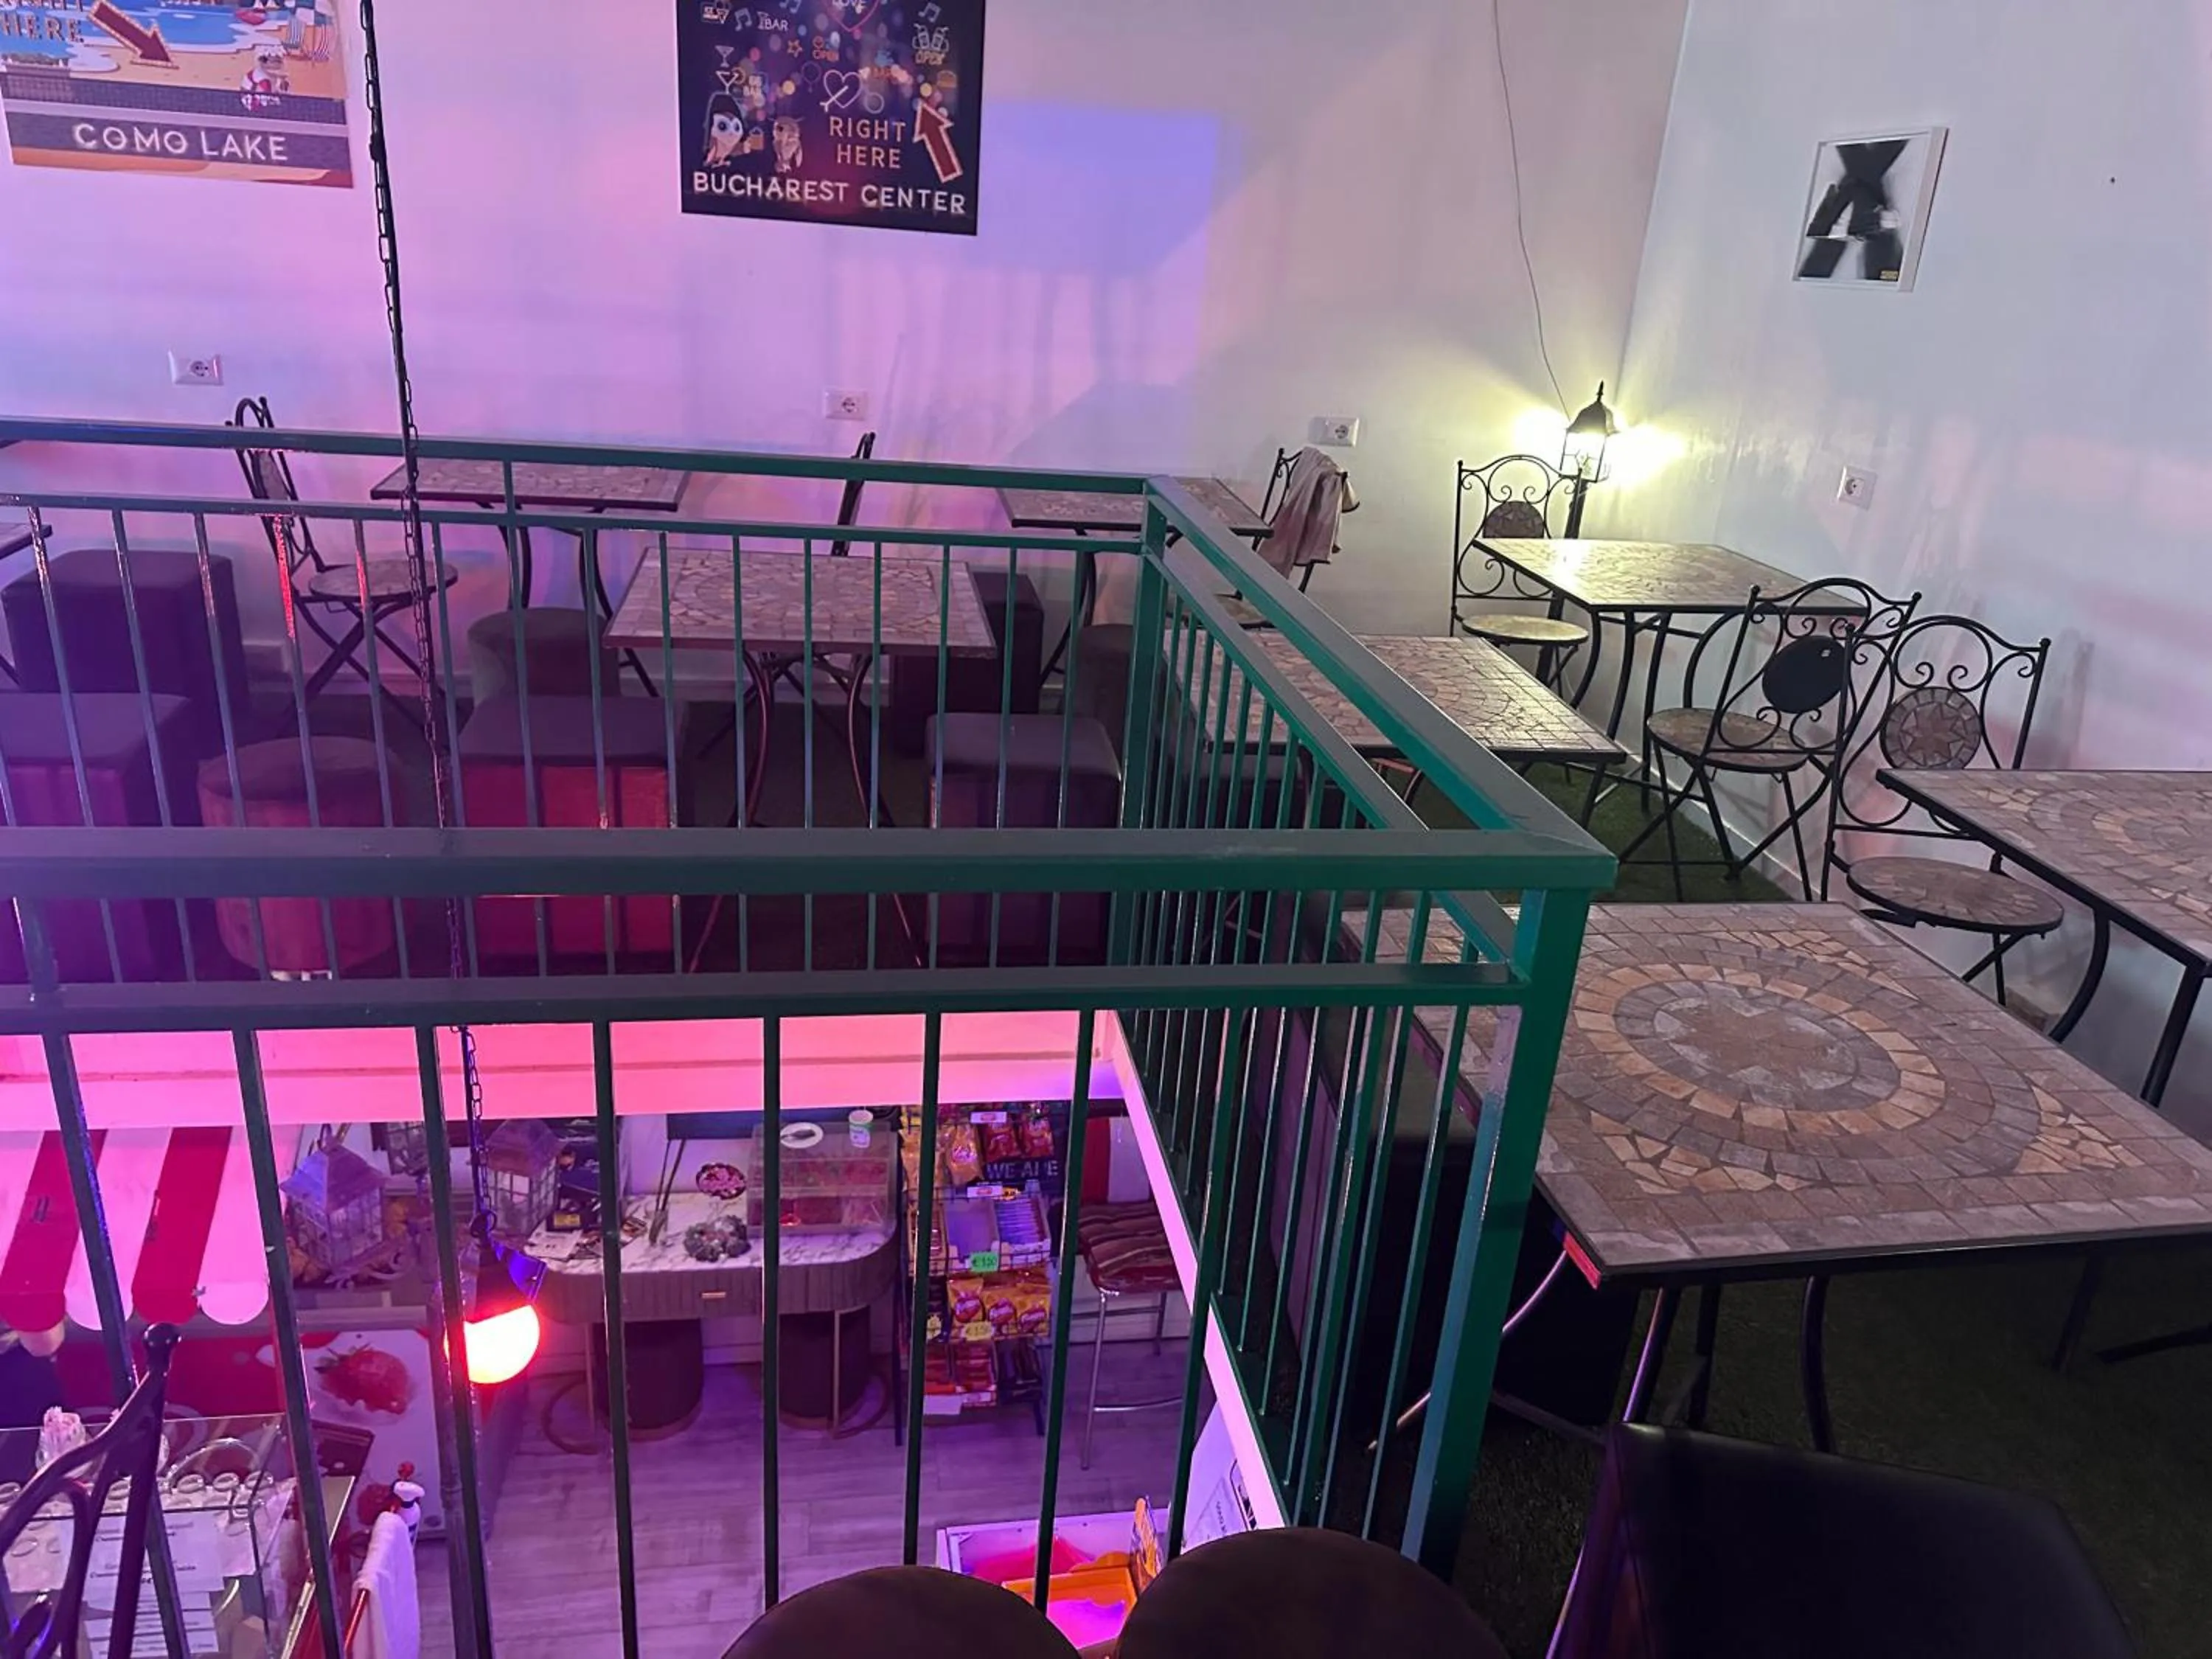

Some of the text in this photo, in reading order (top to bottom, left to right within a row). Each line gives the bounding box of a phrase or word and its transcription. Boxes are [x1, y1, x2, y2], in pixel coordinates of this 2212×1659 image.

[2, 11, 84, 43] HERE
[74, 122, 288, 161] COMO LAKE
[829, 116, 906, 142] RIGHT
[837, 143, 901, 169] HERE
[692, 171, 966, 215] BUCHAREST CENTER
